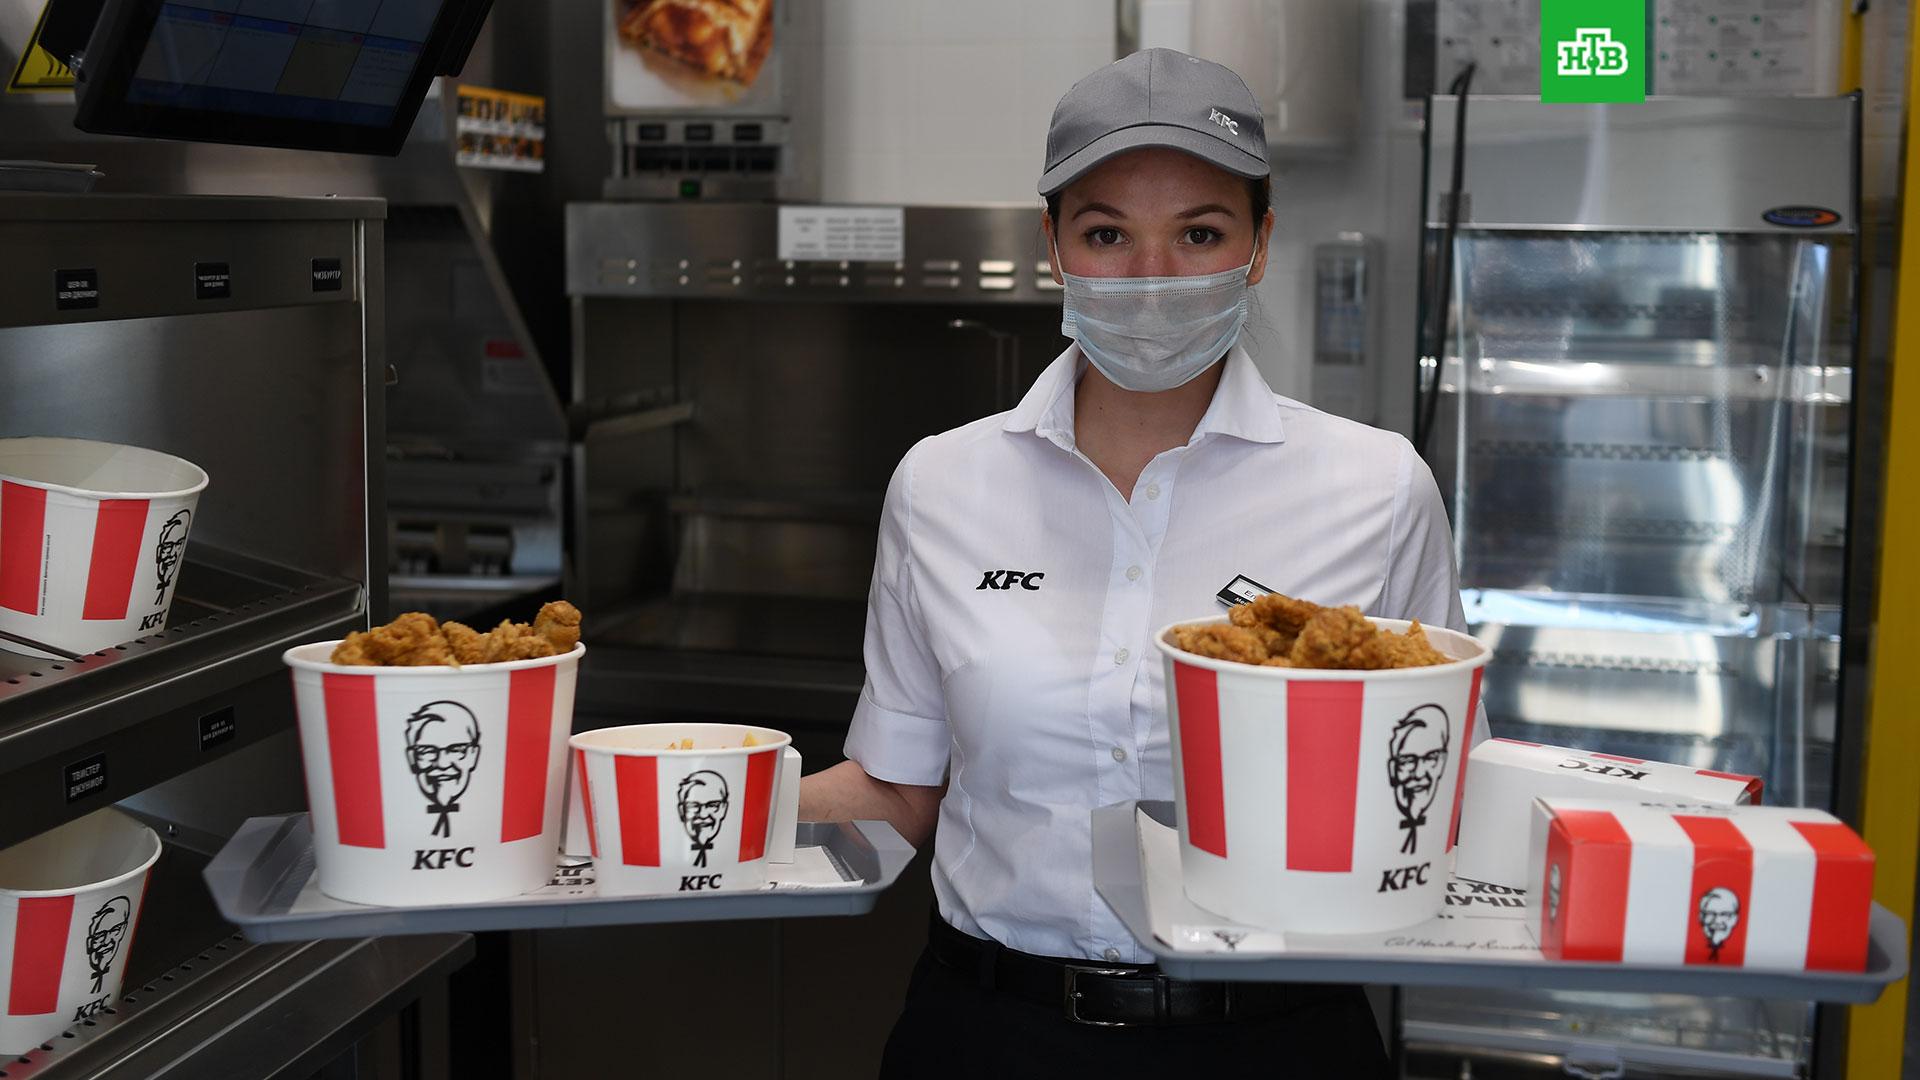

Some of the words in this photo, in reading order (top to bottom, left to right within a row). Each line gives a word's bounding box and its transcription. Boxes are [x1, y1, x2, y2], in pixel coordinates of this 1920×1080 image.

[1209, 108, 1239, 136] KFC
[313, 270, 341, 280] ЧИЗБУРГЕР
[976, 570, 1045, 591] KFC
[138, 609, 167, 631] KFC
[71, 763, 101, 782] ТВИСТЕР
[1558, 759, 1652, 781] KFC
[70, 775, 104, 798] ДЖУНИОР
[412, 847, 475, 870] KFC
[678, 873, 722, 891] KFC
[1377, 862, 1431, 893] KFC
[72, 993, 111, 1022] KFC
